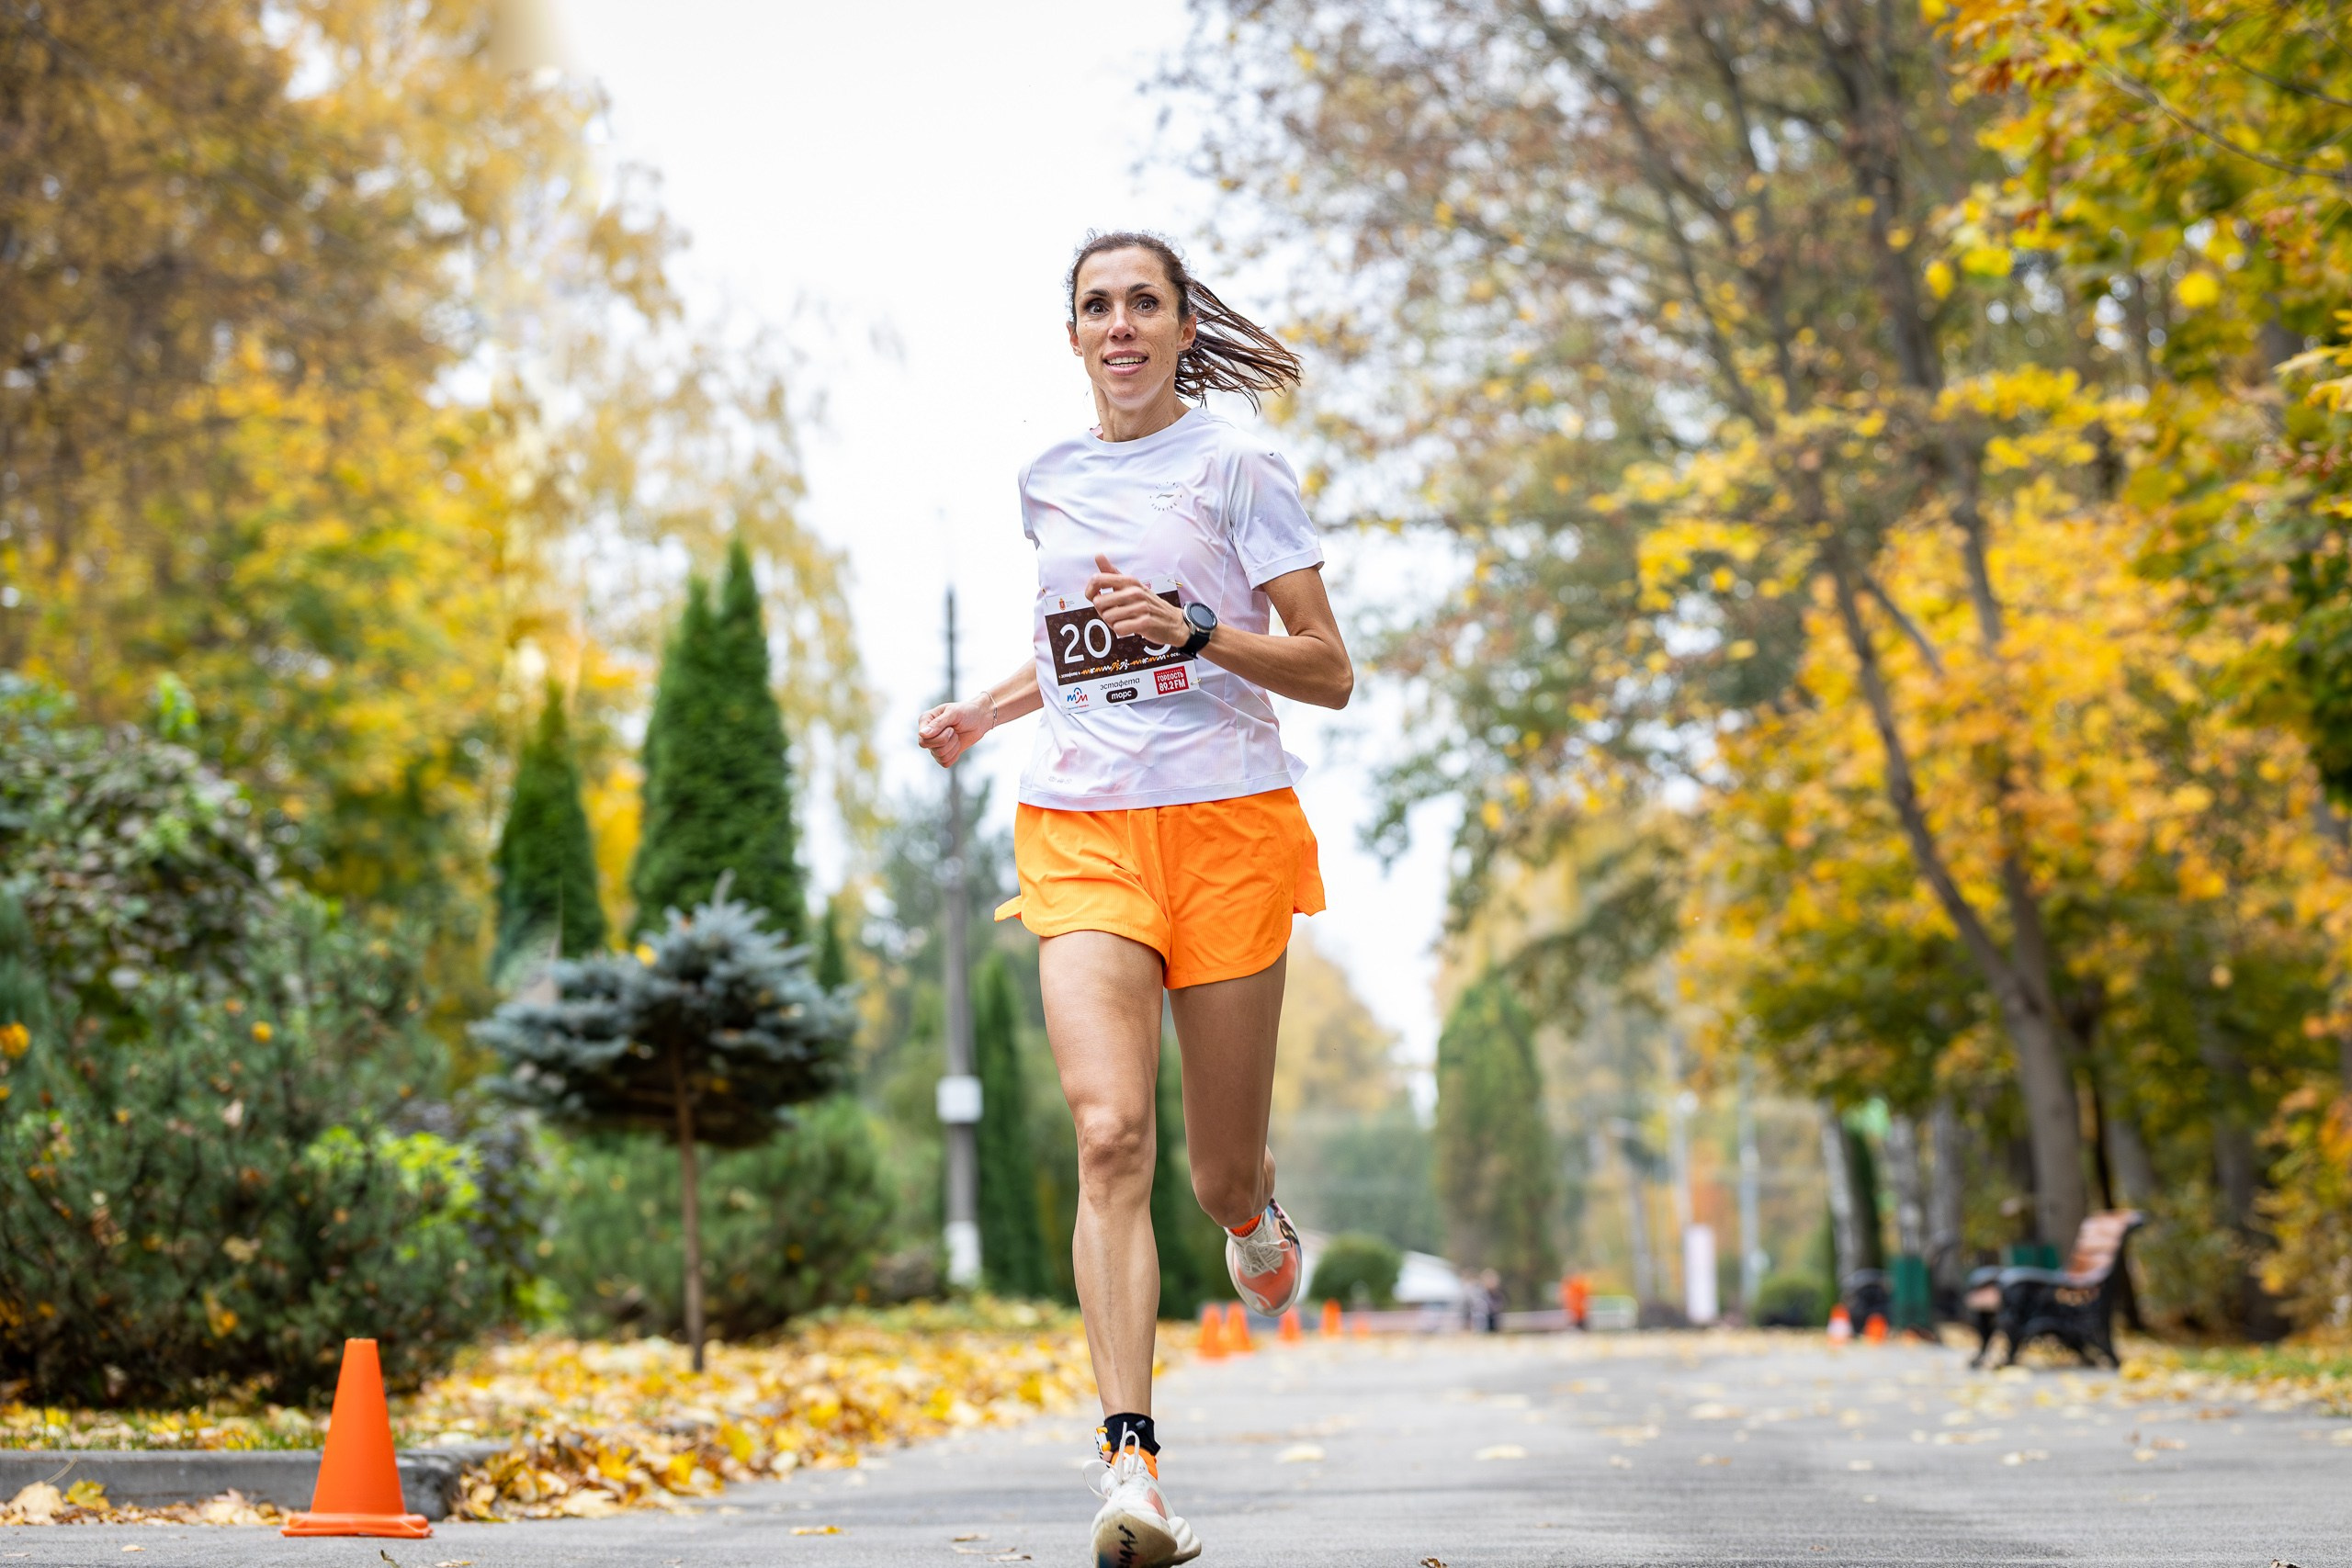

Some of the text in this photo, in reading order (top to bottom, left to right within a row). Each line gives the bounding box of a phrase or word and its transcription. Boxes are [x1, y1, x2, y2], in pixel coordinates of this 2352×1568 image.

[1059, 618, 1171, 664] 20
[1100, 677, 1140, 691] эстафета
[1159, 678, 1186, 692] 89.2 FM
